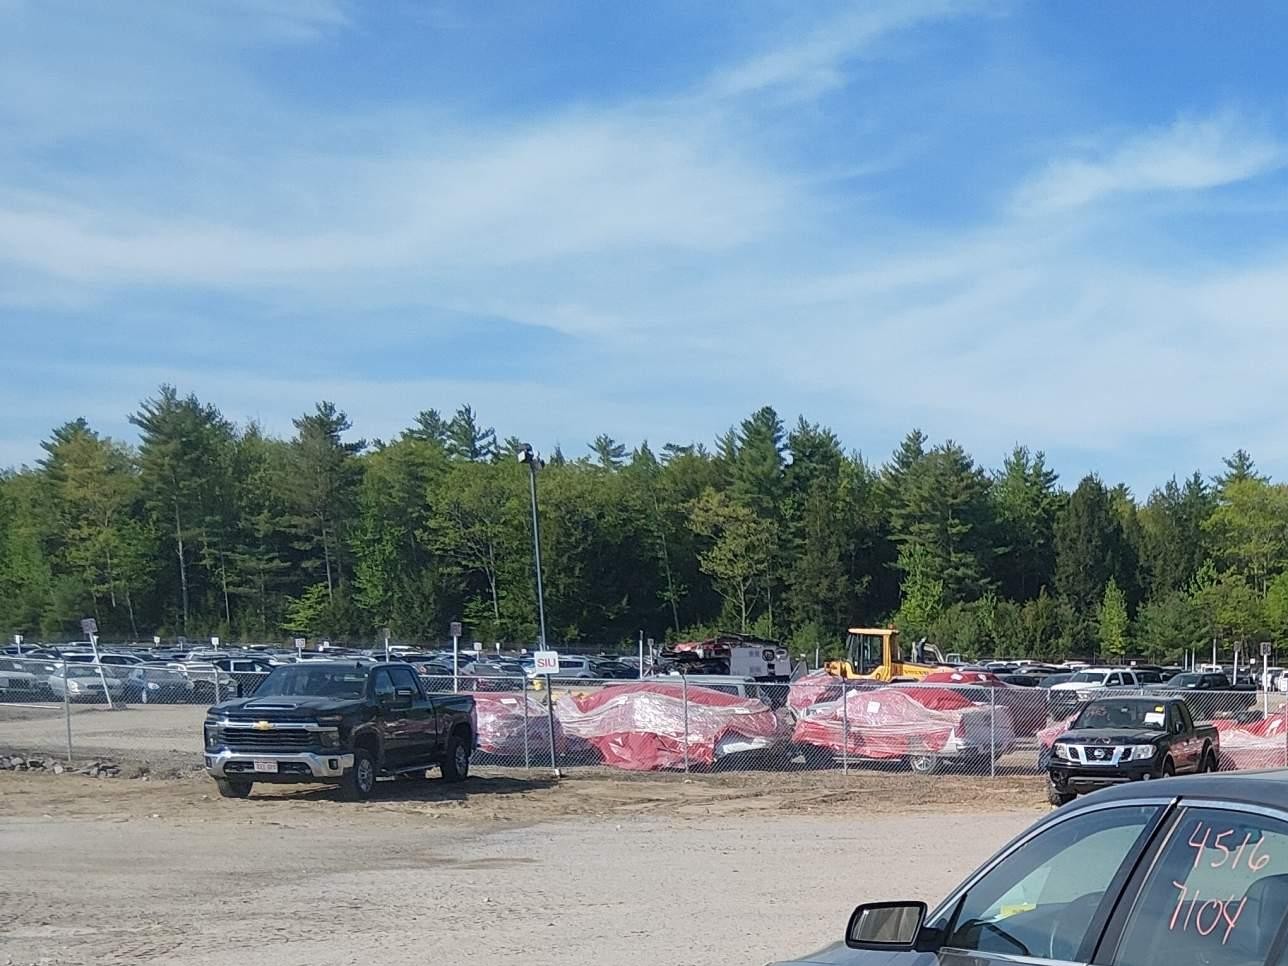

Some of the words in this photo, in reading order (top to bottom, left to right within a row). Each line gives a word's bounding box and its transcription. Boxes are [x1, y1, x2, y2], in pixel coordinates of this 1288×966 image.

[537, 657, 557, 668] SIU
[1188, 821, 1270, 872] 4516
[1168, 880, 1247, 944] 7104
